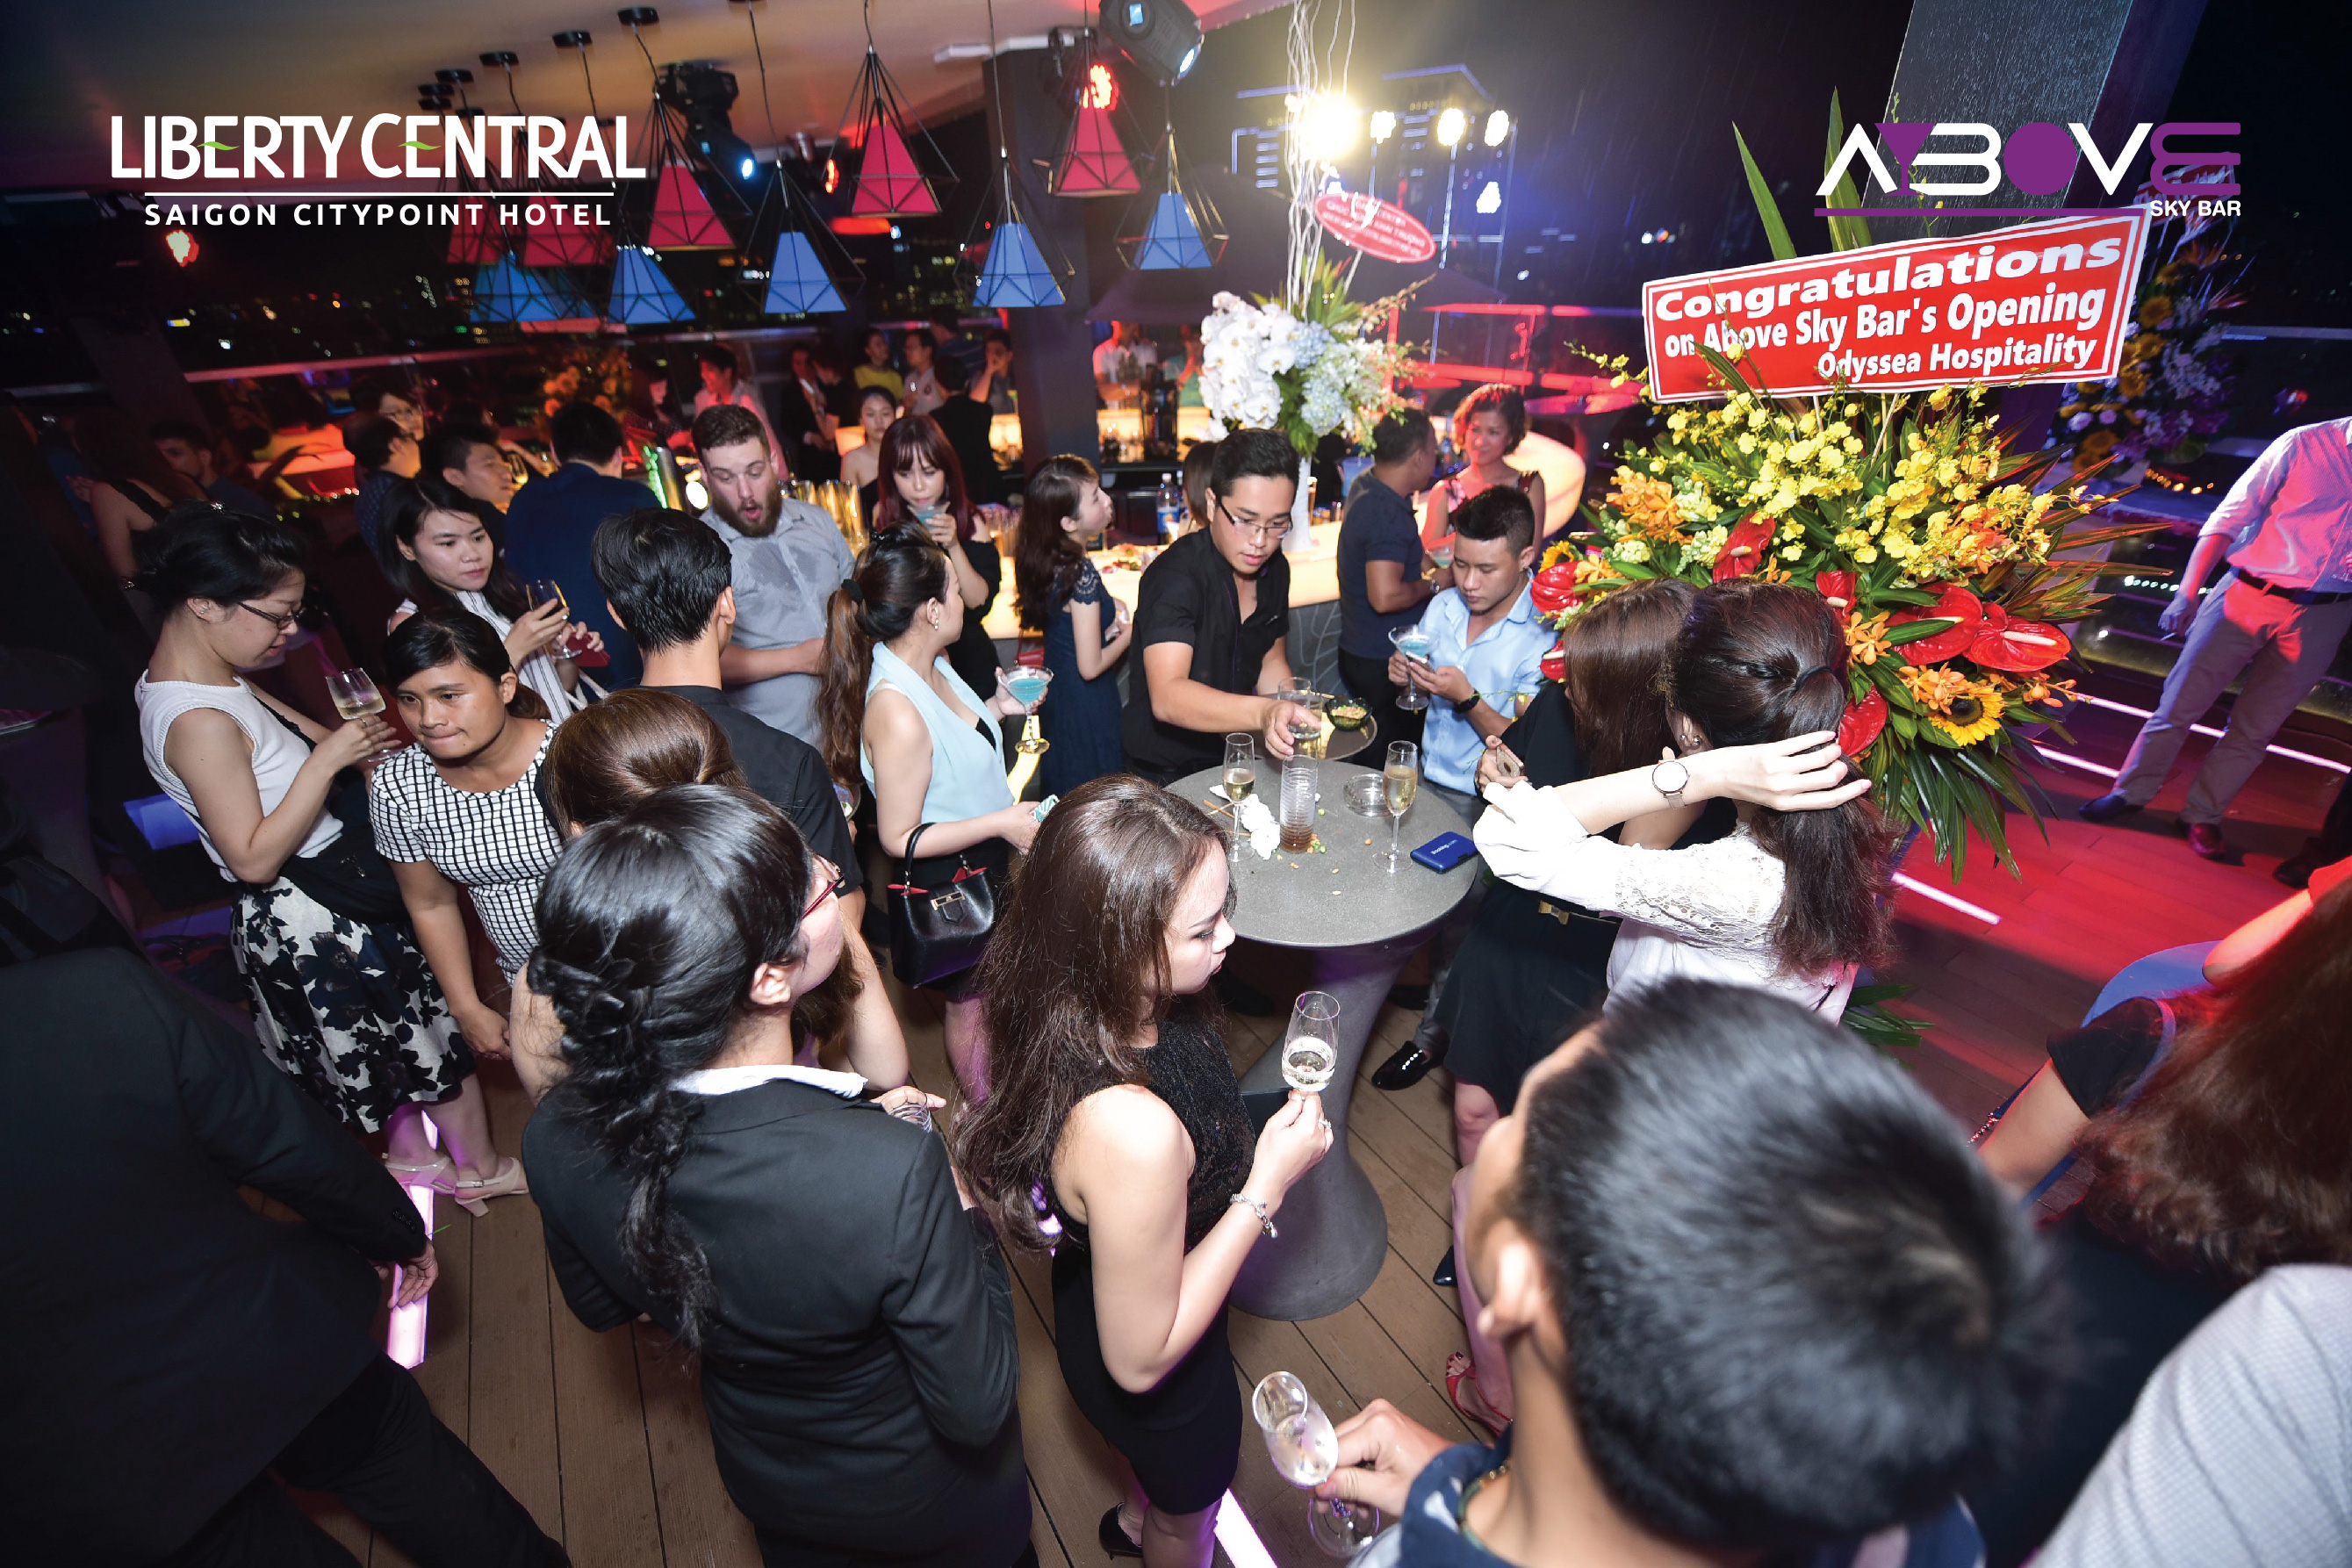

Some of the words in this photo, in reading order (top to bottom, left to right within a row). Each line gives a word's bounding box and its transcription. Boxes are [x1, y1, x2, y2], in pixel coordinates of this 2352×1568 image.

[1655, 236, 2122, 321] Congratulations
[1664, 329, 1696, 358] on
[1703, 319, 1788, 354] Above
[1795, 308, 1848, 352] Sky
[1856, 296, 1938, 340] Bar's
[1946, 281, 2107, 341] Opening
[1817, 349, 1922, 384] Odyssea
[1929, 332, 2098, 377] Hospitality
